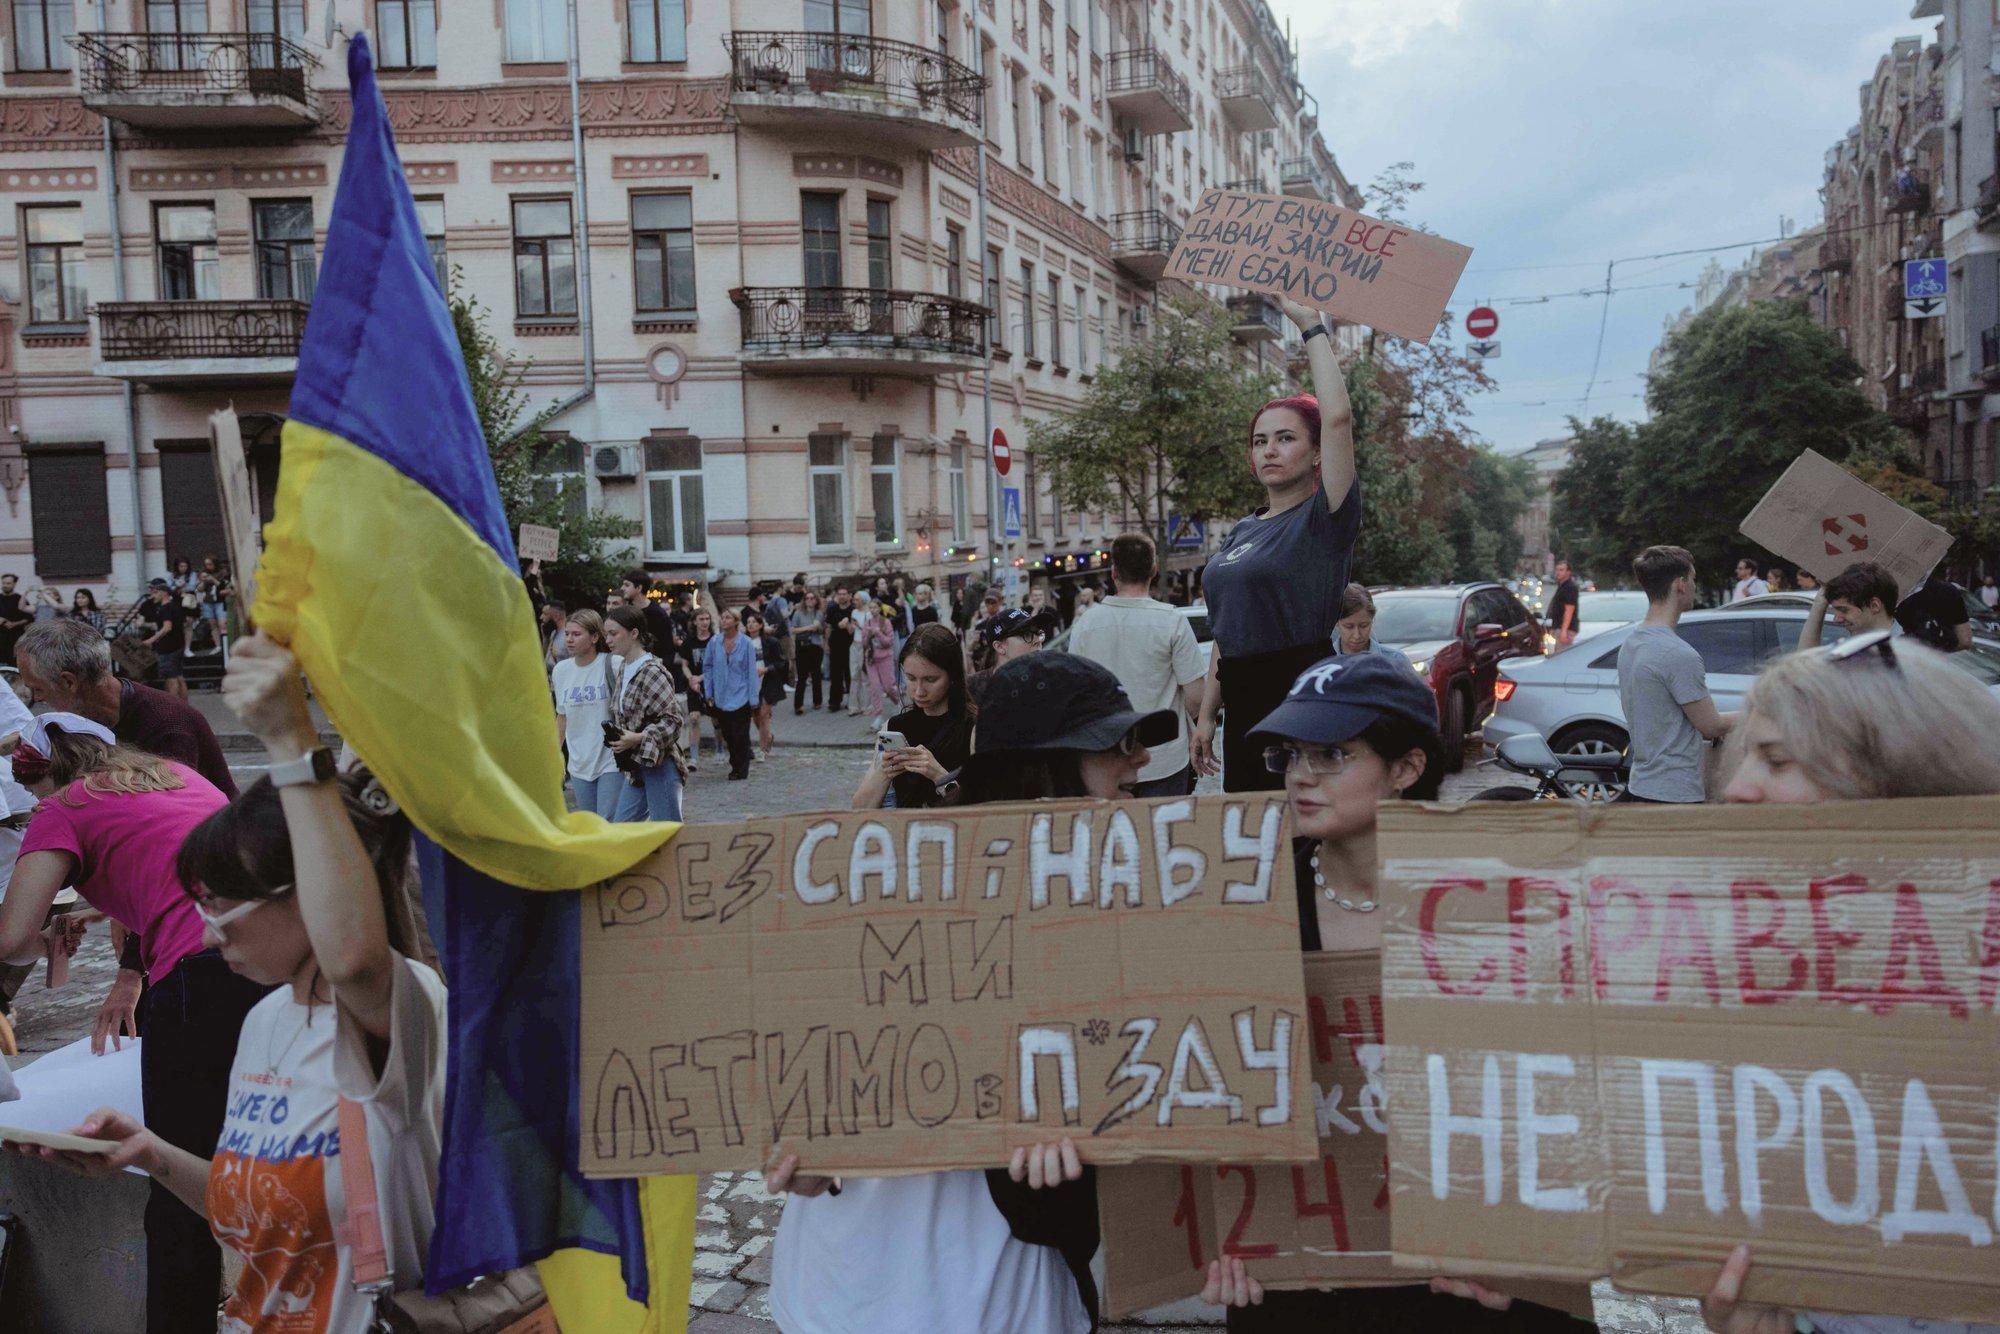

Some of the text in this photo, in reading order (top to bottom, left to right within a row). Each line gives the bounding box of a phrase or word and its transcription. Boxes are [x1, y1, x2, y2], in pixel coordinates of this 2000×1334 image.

[1195, 192, 1409, 258] Я ТУТ БАЧУ ВСЕ
[1278, 229, 1384, 284] ЗАКРИЙ
[1238, 253, 1338, 302] ЄБАЛО
[563, 683, 608, 704] 1431
[597, 832, 774, 932] БЕЗ
[793, 816, 958, 906] САП
[1028, 797, 1288, 911] НАБУ
[860, 914, 1016, 1005] МИ
[592, 1022, 961, 1159] ЛЕТИМО
[1426, 1053, 2000, 1247] НЕ ПРОД
